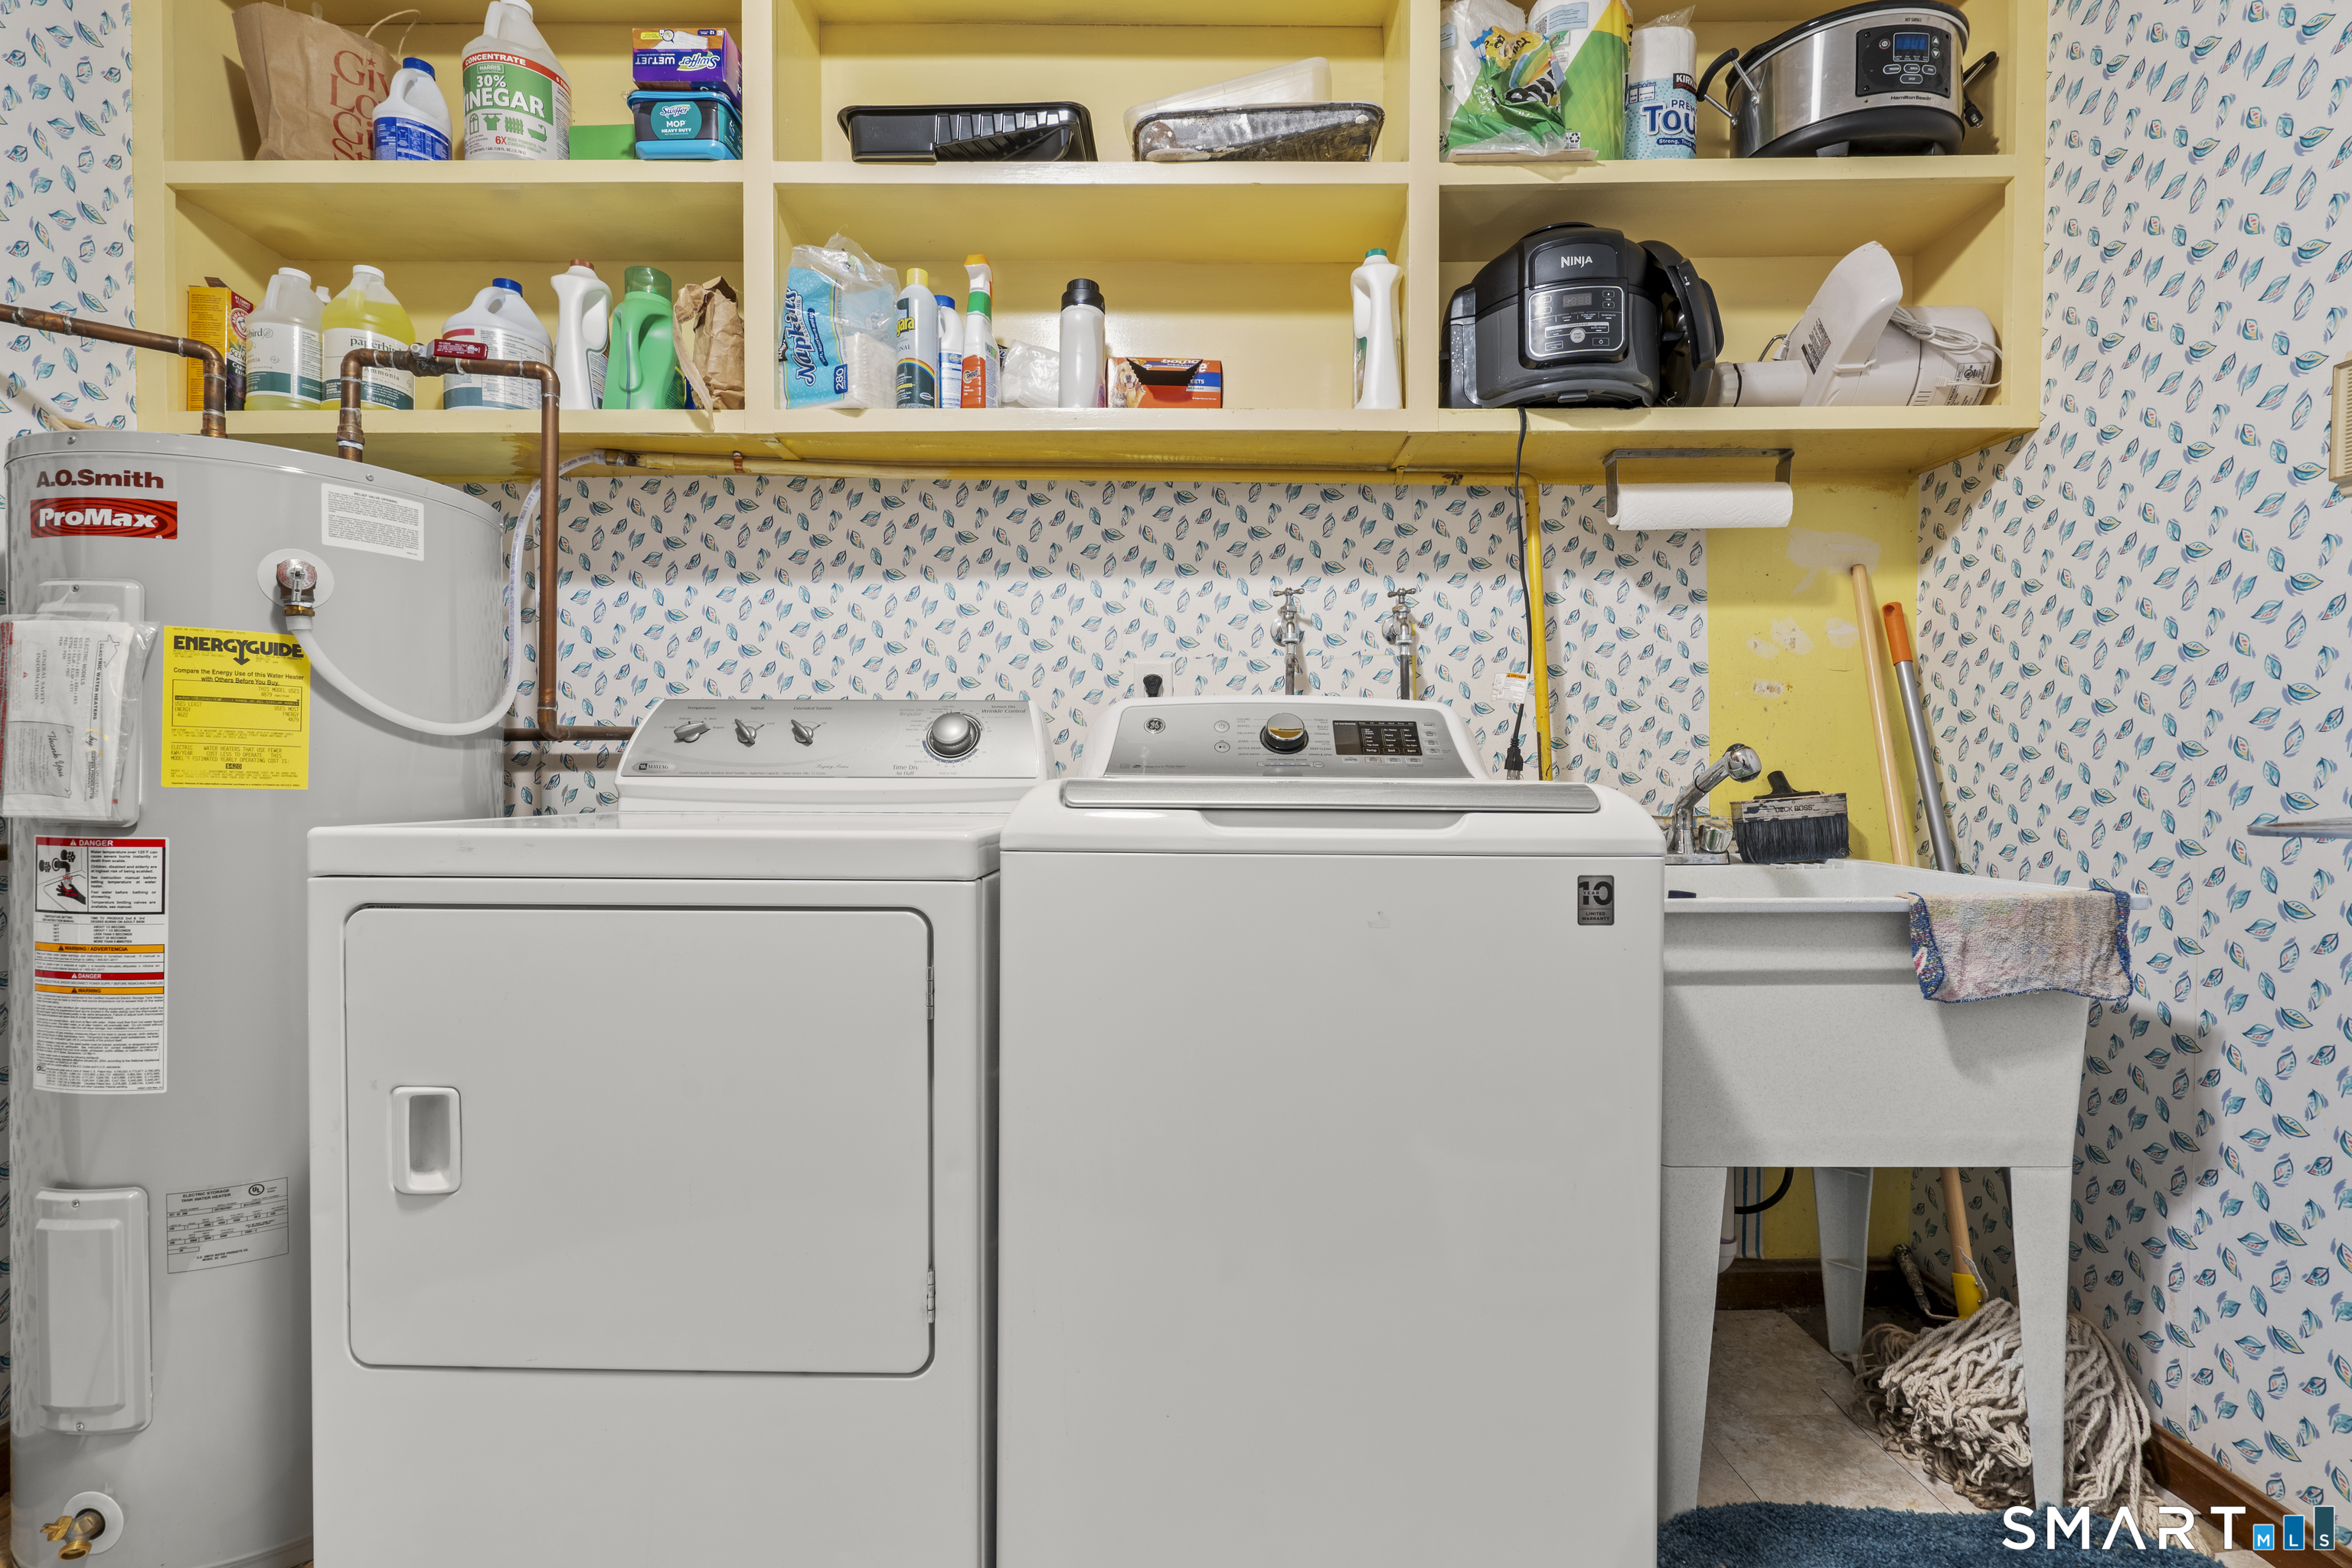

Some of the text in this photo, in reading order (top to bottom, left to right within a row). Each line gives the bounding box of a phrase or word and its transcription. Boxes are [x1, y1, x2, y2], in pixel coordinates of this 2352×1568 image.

[466, 54, 526, 66] CONCENTRATE
[635, 53, 720, 69] Swiffer WETJET
[476, 74, 507, 88] 30%
[330, 74, 378, 120] LO
[660, 106, 688, 116] Swiffer
[1671, 100, 1697, 114] PREM
[495, 136, 507, 145] 6X
[518, 139, 537, 149] POWERFUL
[527, 145, 541, 155] VINEGAR
[1560, 256, 1593, 269] NINJA
[897, 317, 915, 338] gara
[785, 286, 817, 387] Napkins
[835, 368, 844, 390] 280
[36, 469, 164, 488] A.O.Smith
[39, 508, 157, 528] ProMax
[174, 635, 304, 658] ENERGYGUIDE
[47, 731, 64, 778] Thank You
[1579, 881, 1612, 905] 10
